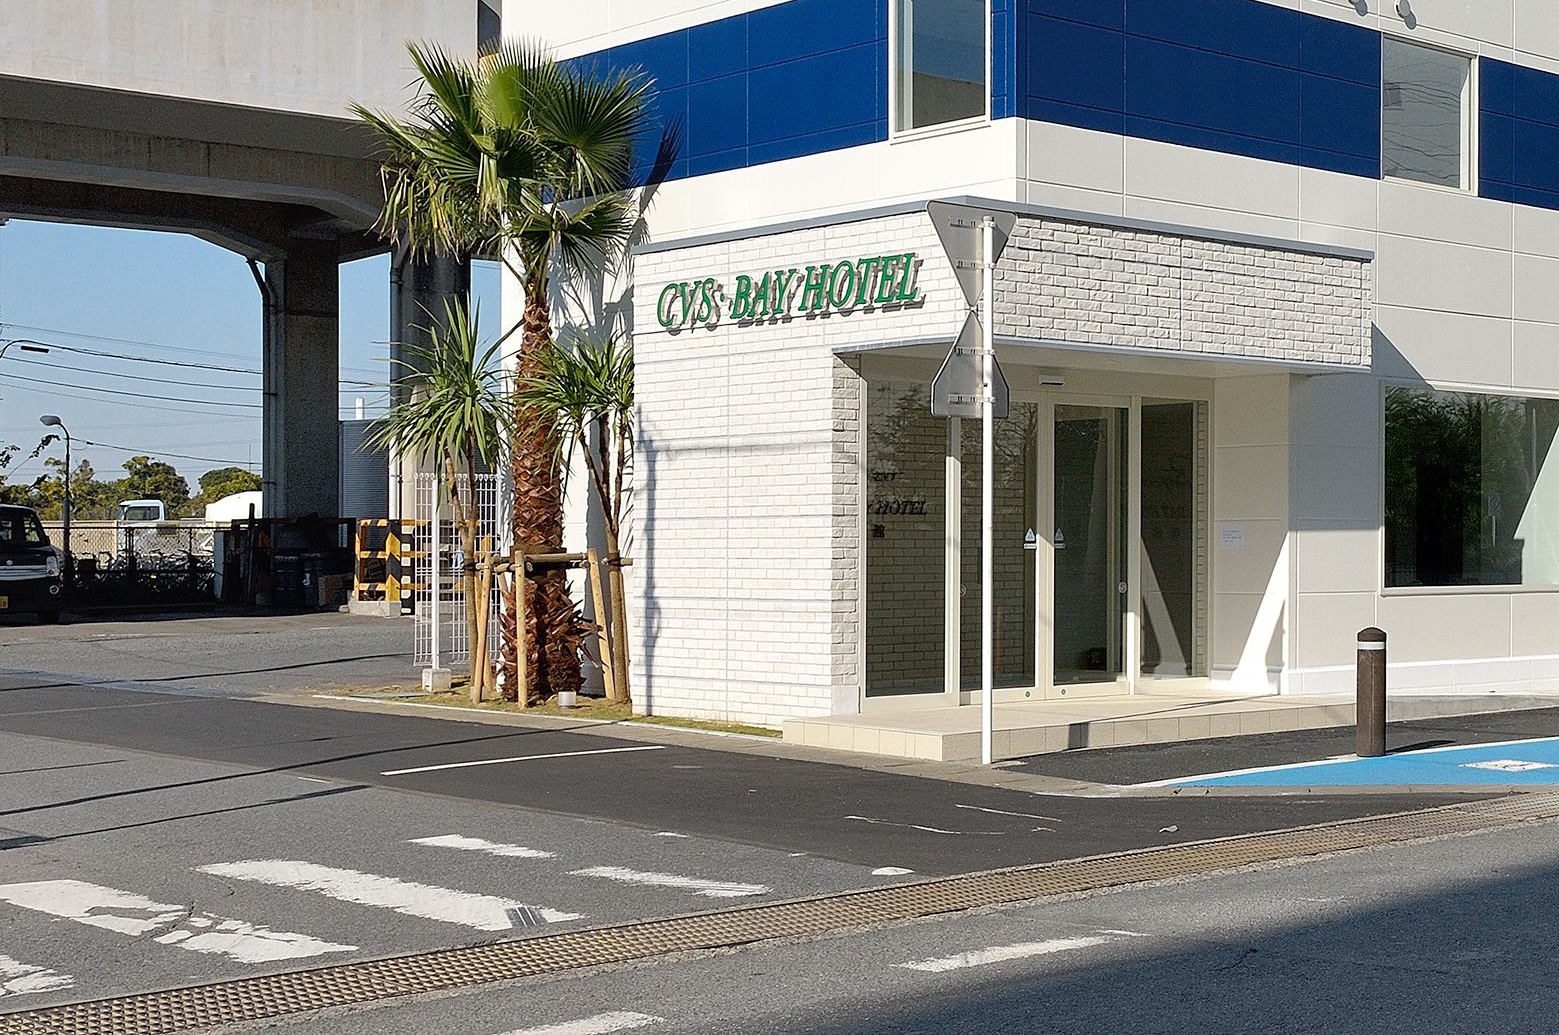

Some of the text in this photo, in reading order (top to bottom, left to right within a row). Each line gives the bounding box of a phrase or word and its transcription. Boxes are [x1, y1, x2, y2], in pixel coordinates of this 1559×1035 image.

[731, 268, 795, 319] BAY
[801, 252, 919, 311] HOTEL
[875, 499, 928, 515] HOTEL
